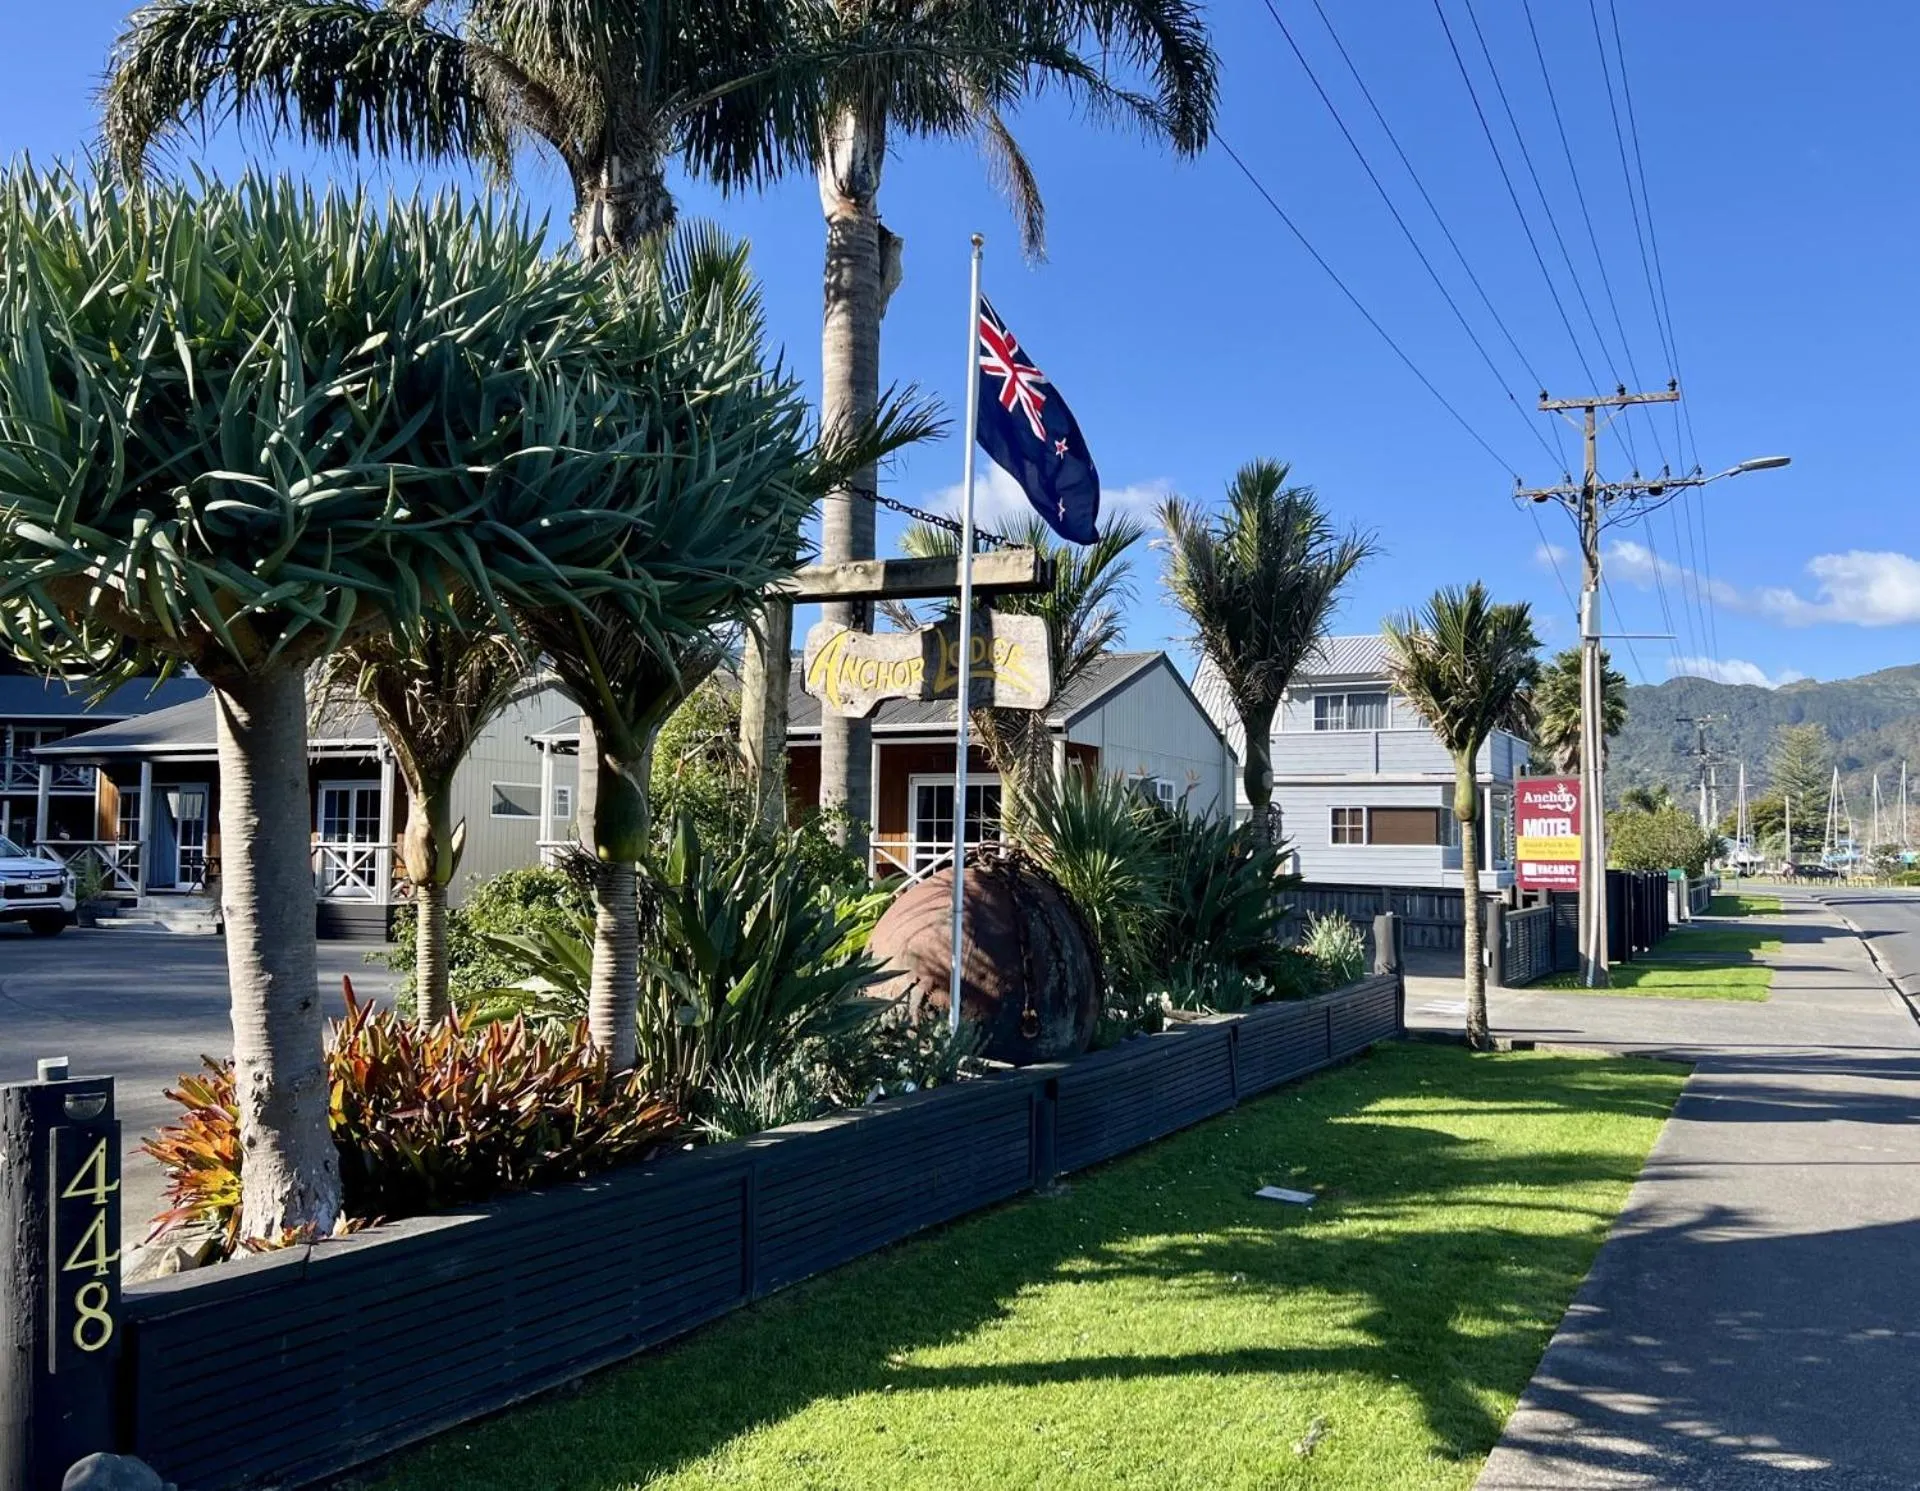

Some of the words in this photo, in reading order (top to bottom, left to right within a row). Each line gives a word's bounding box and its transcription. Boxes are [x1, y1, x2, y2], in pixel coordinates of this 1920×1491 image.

[807, 629, 926, 711] ANCHOR
[1522, 818, 1575, 838] MOTEL
[1537, 864, 1576, 876] VACANCY
